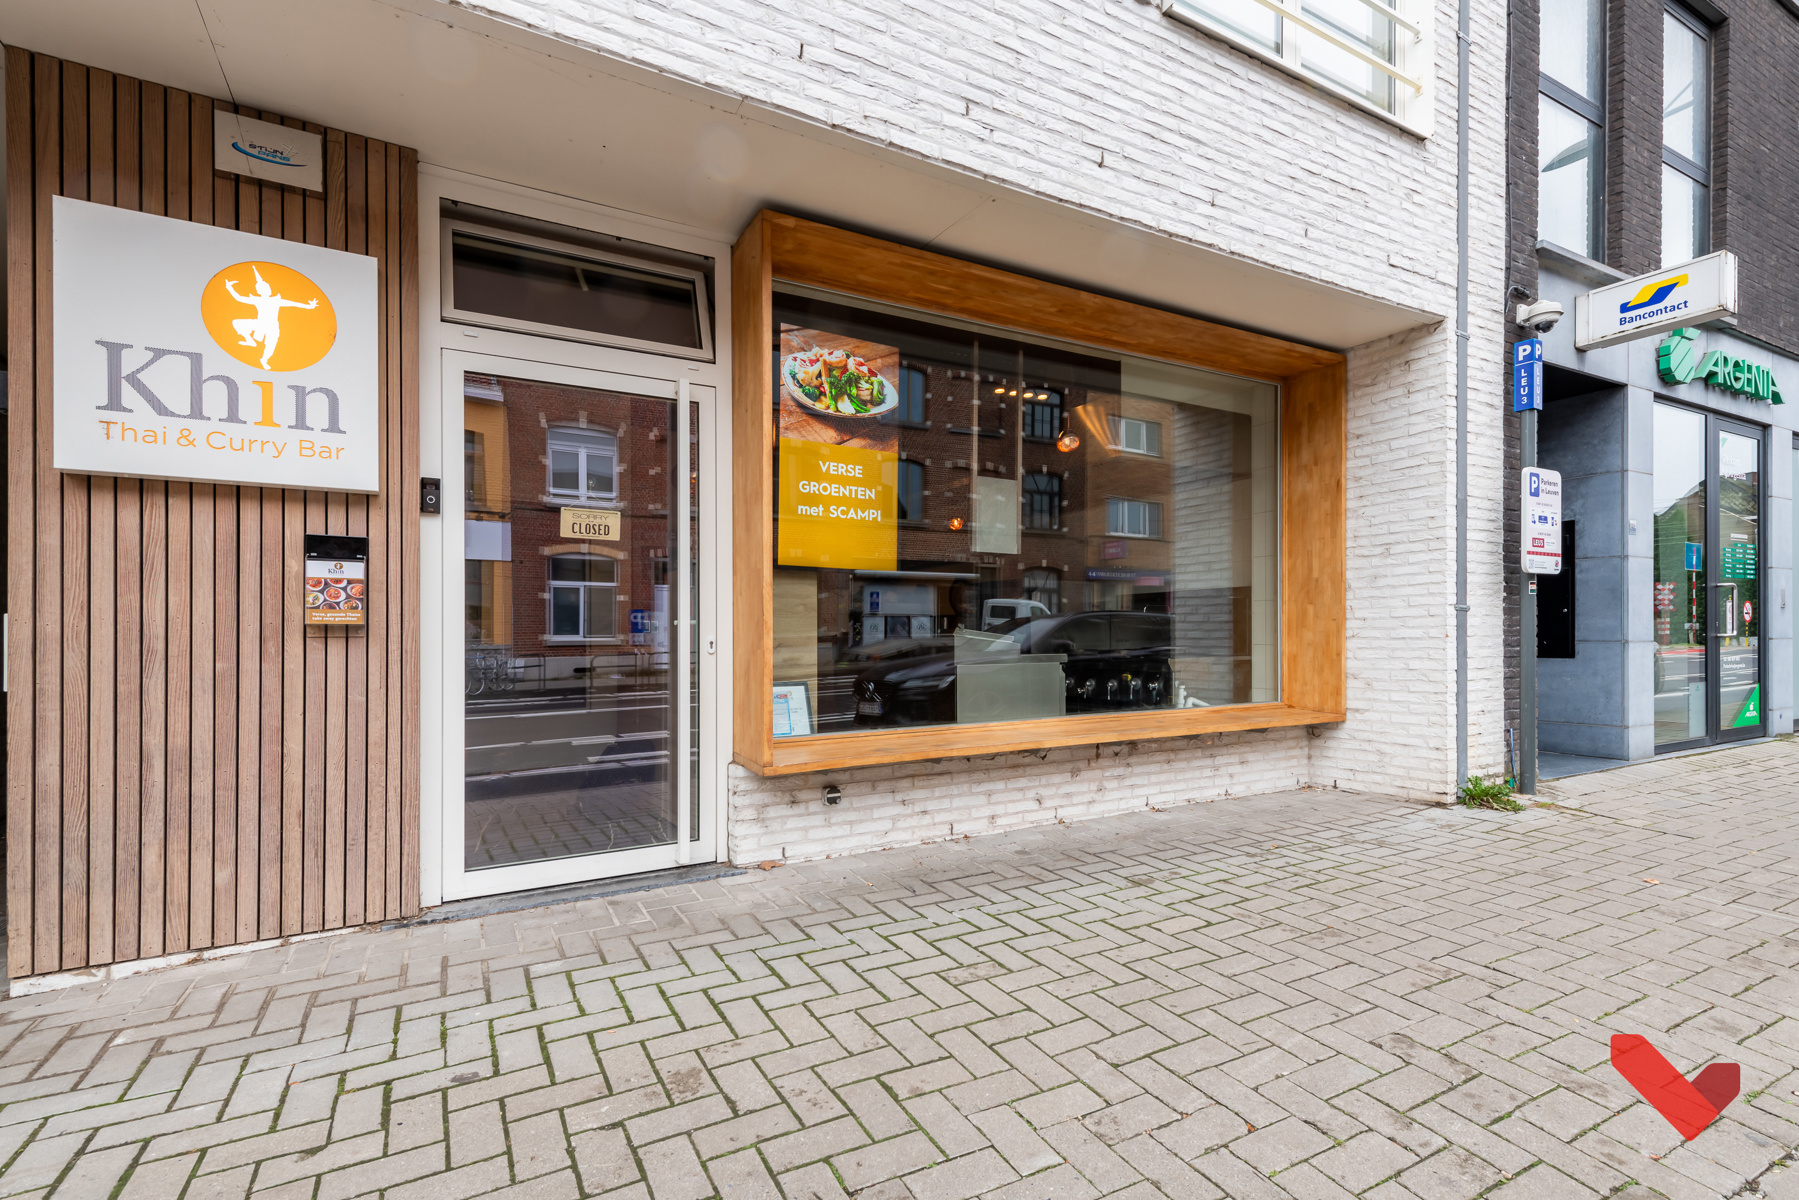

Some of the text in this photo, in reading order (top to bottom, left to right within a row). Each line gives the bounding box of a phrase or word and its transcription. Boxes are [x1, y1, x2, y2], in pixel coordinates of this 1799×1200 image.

[1619, 300, 1689, 326] Bancontact
[1518, 344, 1531, 361] P
[1693, 350, 1786, 405] ARGENTA
[95, 339, 347, 435] Khin
[98, 420, 345, 460] Thai & Curry Bar
[818, 460, 863, 478] VERSE
[798, 480, 876, 500] GROENTEN
[1540, 478, 1559, 487] Parkeren
[571, 512, 610, 521] SORRY
[797, 504, 882, 522] met SCAMPI
[571, 522, 610, 536] CLOSED
